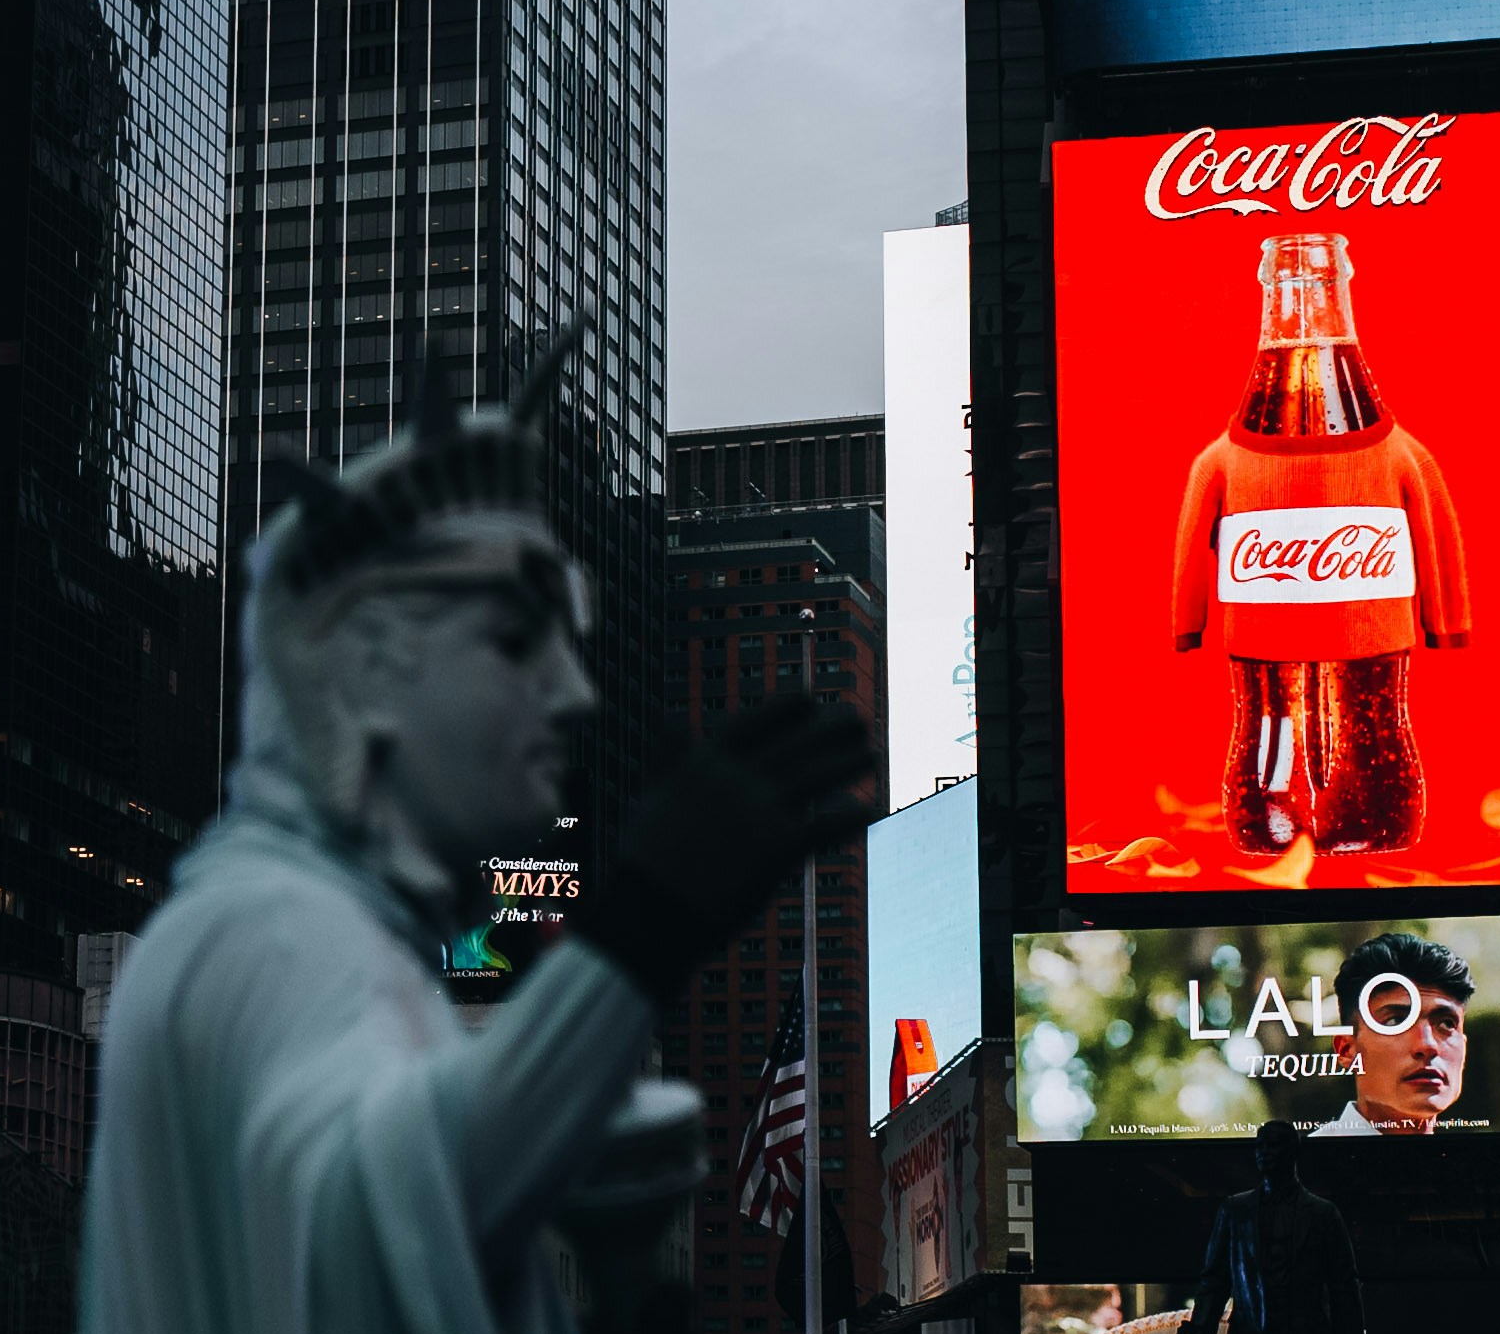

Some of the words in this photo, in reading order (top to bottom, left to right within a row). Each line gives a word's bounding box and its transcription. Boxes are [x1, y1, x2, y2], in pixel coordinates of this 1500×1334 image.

[1144, 113, 1457, 221] Coca-Cola
[1230, 523, 1401, 583] Coca-Cola
[488, 856, 580, 873] Consideration
[490, 908, 507, 924] of
[507, 908, 529, 923] the
[1188, 972, 1422, 1041] LALO
[1244, 1052, 1366, 1082] TEQUILA
[1110, 1123, 1138, 1135] LALO
[1138, 1123, 1170, 1136] Tequila
[1171, 1123, 1200, 1135] blanco
[1401, 1119, 1416, 1130] TX
[888, 1136, 941, 1202] MISSIONARY
[940, 1104, 971, 1164] STYLE
